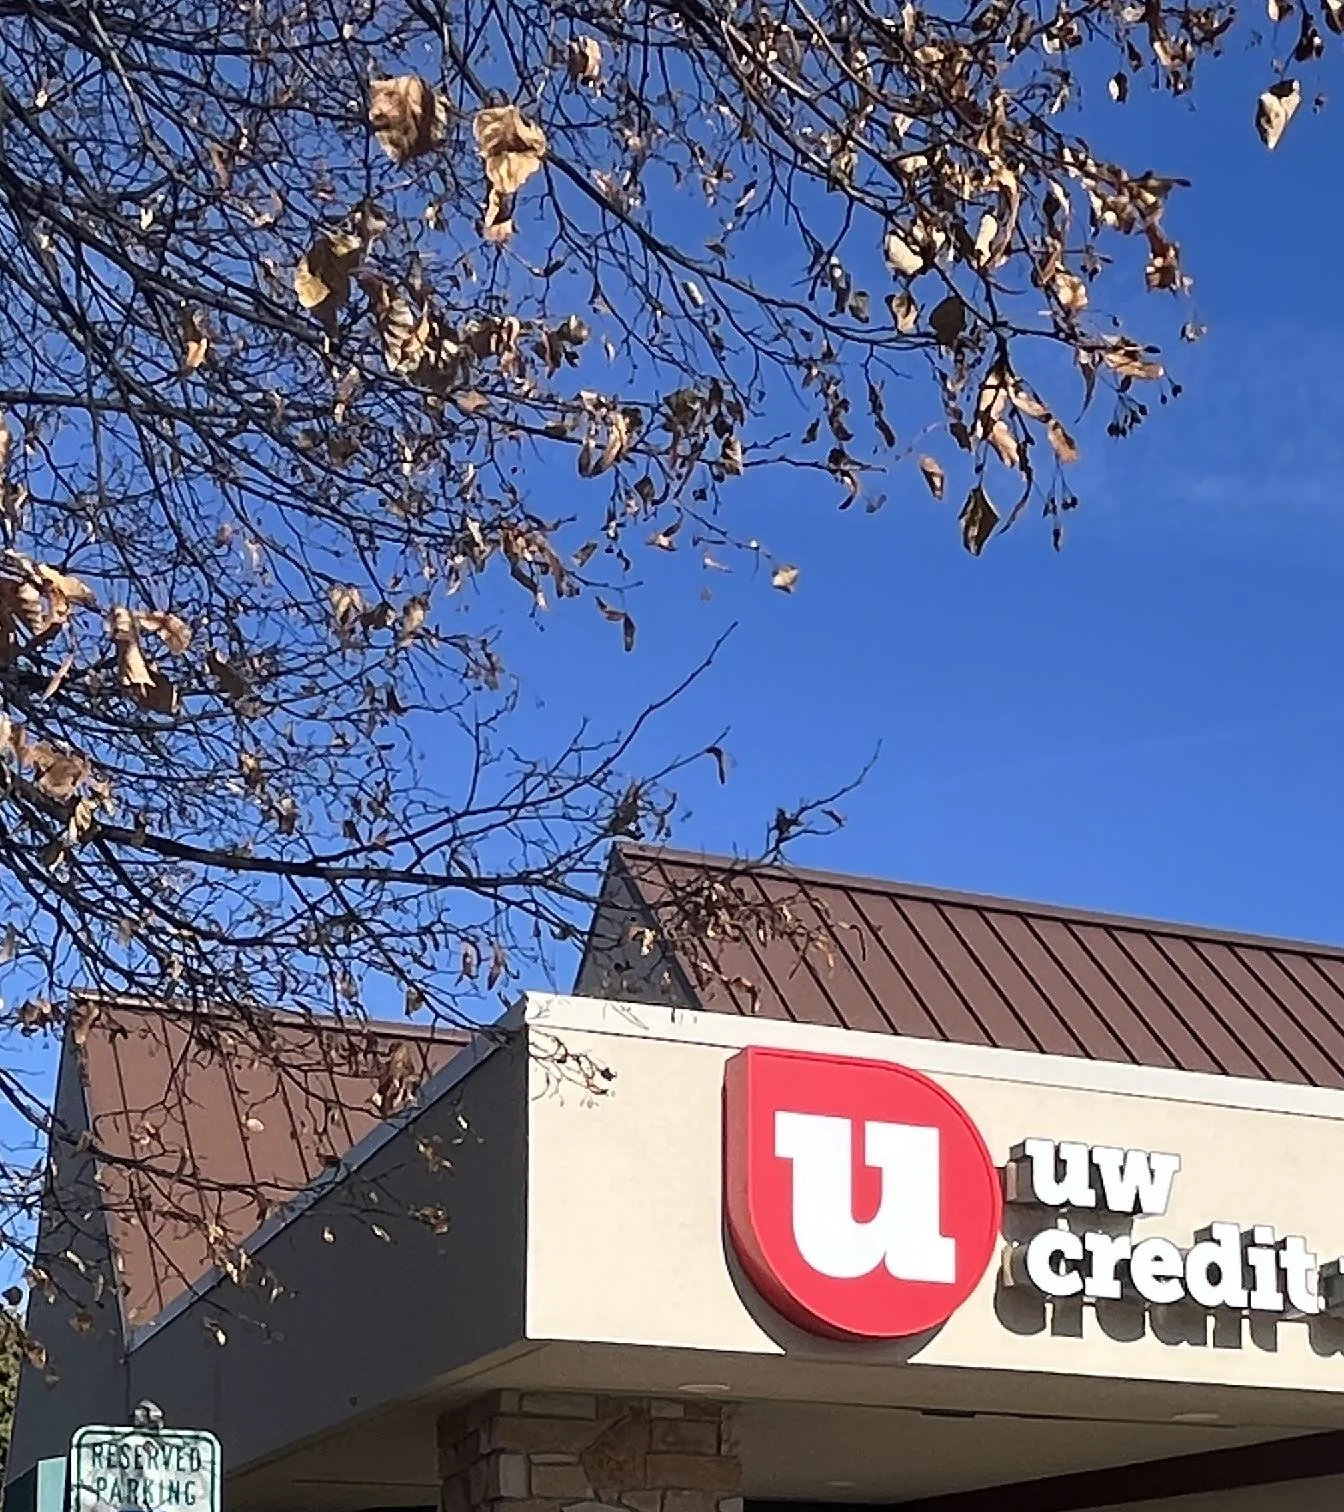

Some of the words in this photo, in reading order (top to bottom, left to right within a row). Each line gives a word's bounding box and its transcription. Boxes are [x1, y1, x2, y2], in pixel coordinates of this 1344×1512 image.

[774, 1110, 957, 1284] u
[1024, 1136, 1182, 1216] uw
[1026, 1221, 1320, 1315] credit
[93, 1443, 202, 1472] RESERVED
[96, 1477, 196, 1506] PARKING
